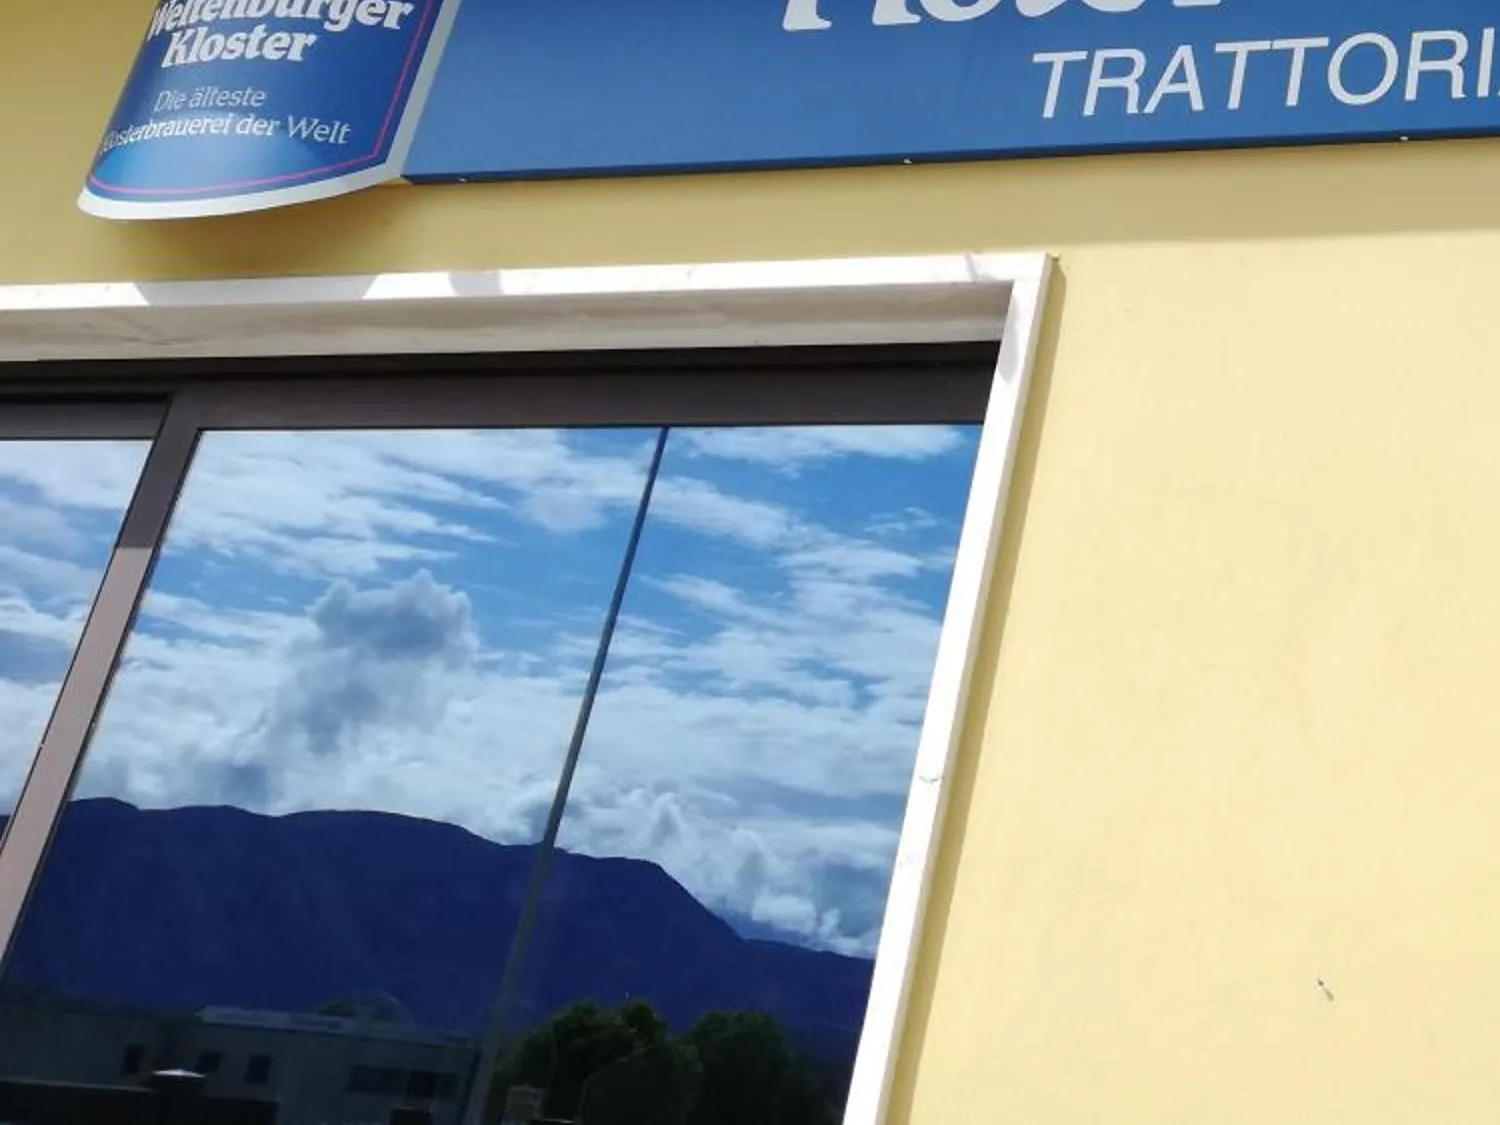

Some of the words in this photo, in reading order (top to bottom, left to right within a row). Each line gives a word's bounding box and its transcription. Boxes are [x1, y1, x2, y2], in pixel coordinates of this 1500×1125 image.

[161, 23, 317, 68] Kloster
[153, 89, 187, 113] Die
[188, 85, 267, 109] älteste
[236, 114, 280, 137] der
[286, 115, 352, 145] Welt
